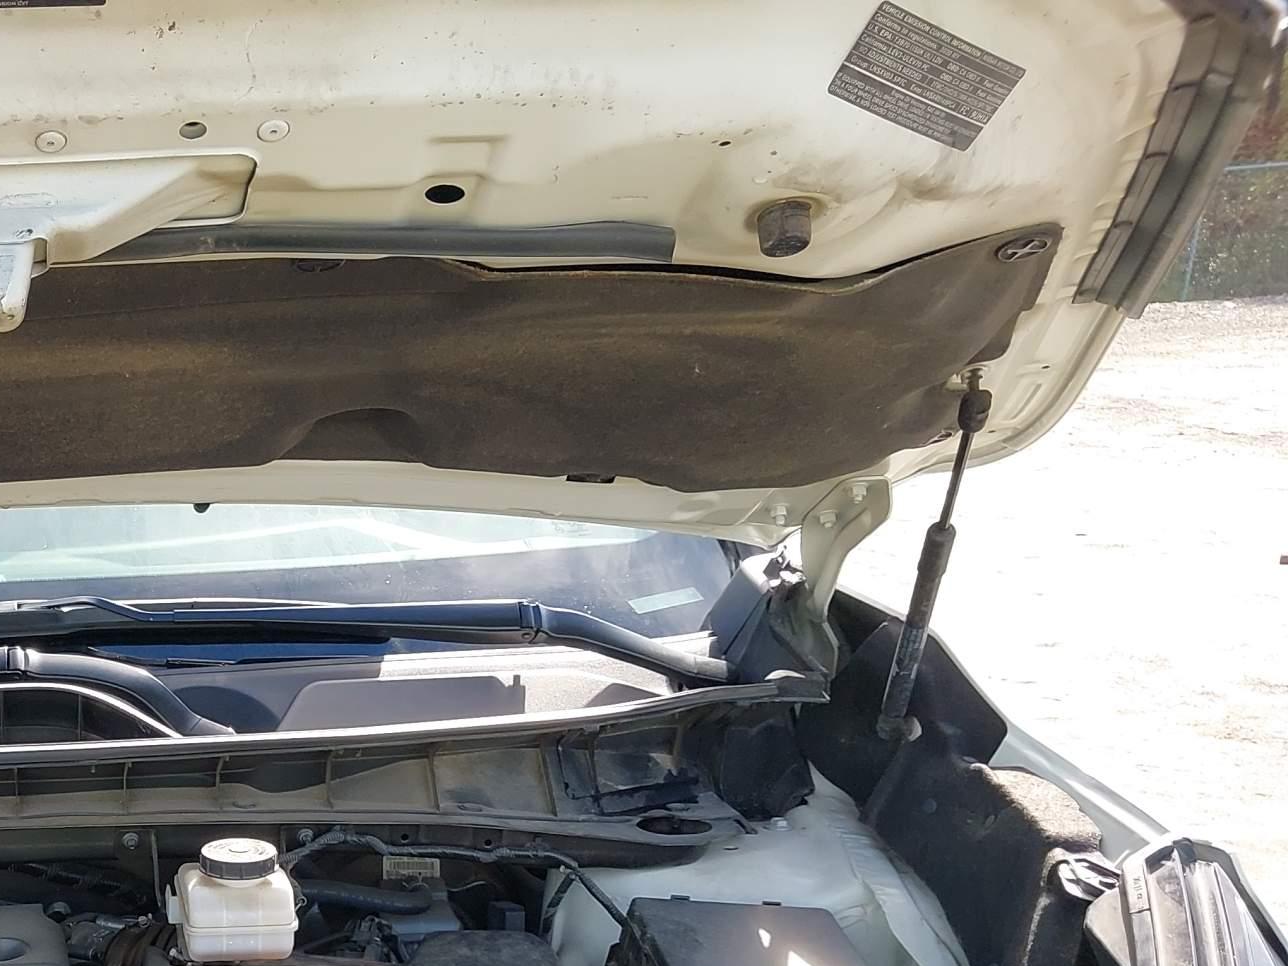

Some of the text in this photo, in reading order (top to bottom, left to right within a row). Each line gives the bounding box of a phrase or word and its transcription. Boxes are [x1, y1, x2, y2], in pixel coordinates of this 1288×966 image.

[881, 3, 905, 18] VEHICLE
[904, 15, 930, 31] EMISSION
[928, 27, 952, 42] CONTROL
[866, 49, 903, 71] ADJUSTMENTS
